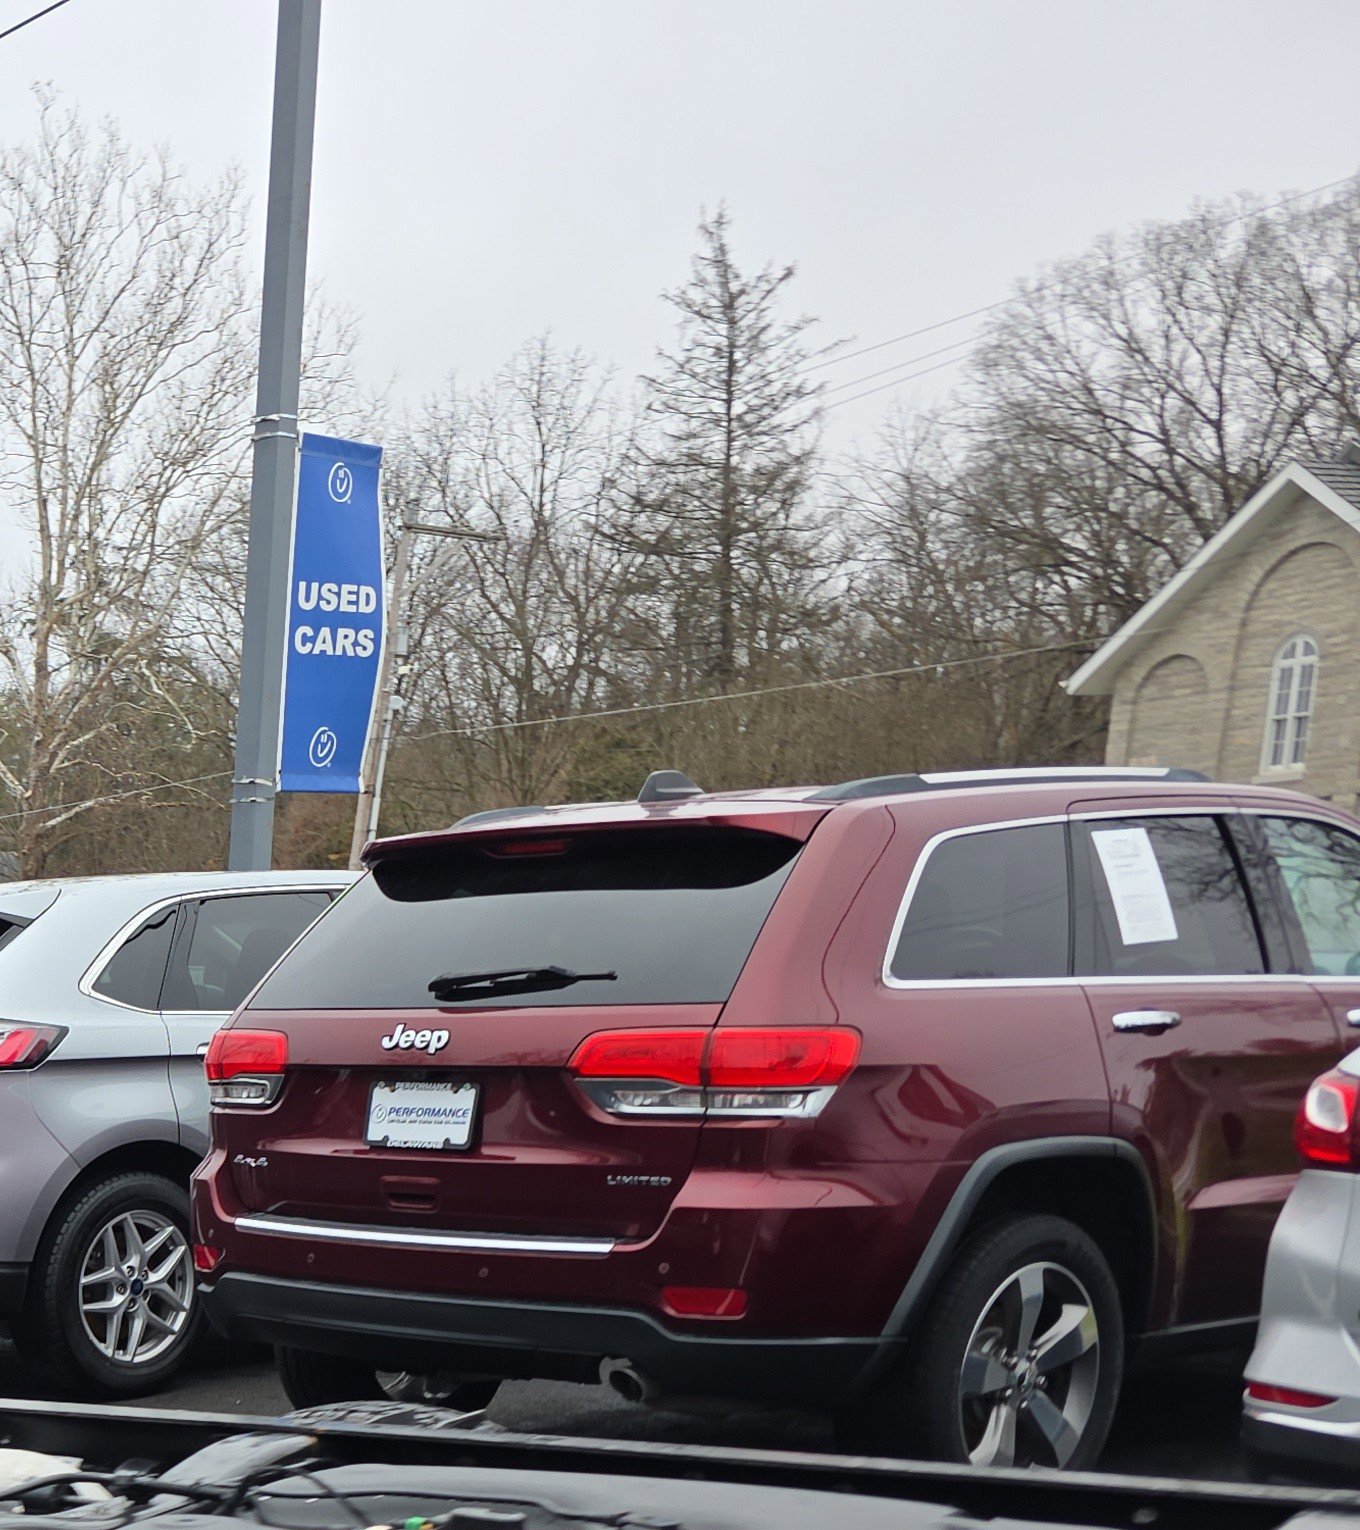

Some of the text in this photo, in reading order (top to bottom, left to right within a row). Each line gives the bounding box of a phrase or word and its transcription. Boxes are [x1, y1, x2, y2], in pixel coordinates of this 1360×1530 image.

[297, 581, 377, 614] USED
[294, 625, 375, 658] CARS
[381, 1023, 450, 1055] Jeep
[387, 1106, 471, 1119] PERFORMANCE
[606, 1174, 673, 1187] LIMITED
